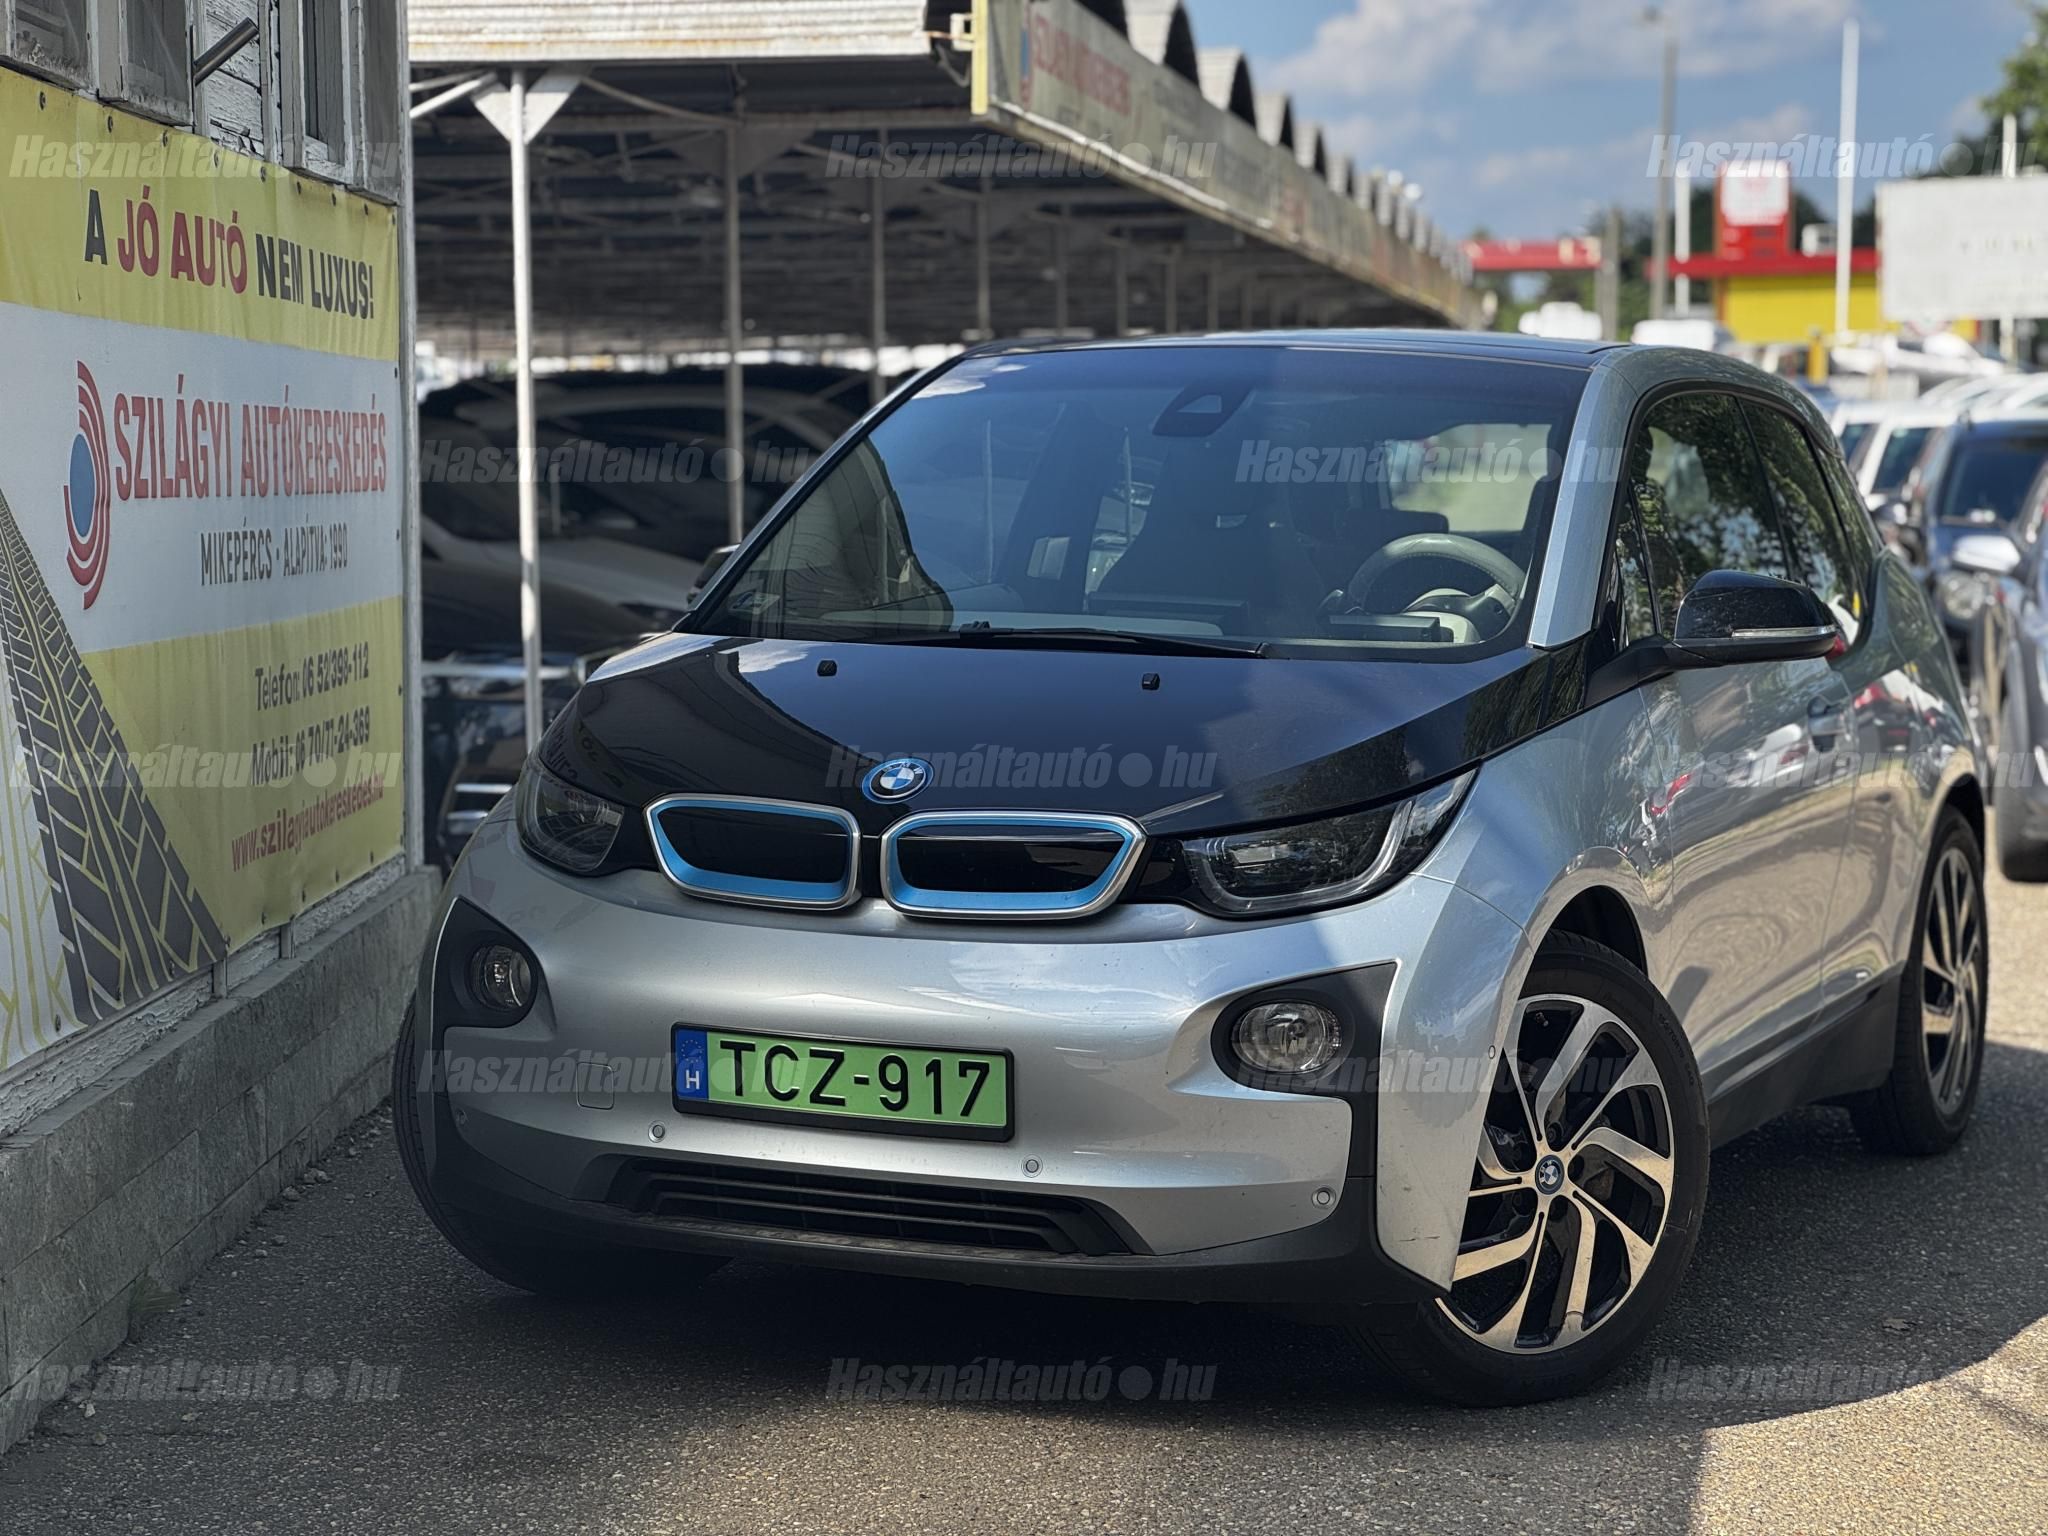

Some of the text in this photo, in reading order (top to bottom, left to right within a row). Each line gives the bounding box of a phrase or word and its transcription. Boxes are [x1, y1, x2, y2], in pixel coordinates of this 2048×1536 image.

[84, 184, 374, 319] A JÓ AUTÓ NEM LUXUS!
[113, 373, 387, 501] SZILÁGYI AUTÓKERESKEDÉS
[200, 513, 348, 586] MIKEPÉRCS ALAPÍTVA: 1990
[255, 663, 301, 712] Telefon:
[302, 656, 314, 699] 06
[252, 734, 294, 786] Mobil:
[685, 1039, 990, 1118] H TCZ-917
